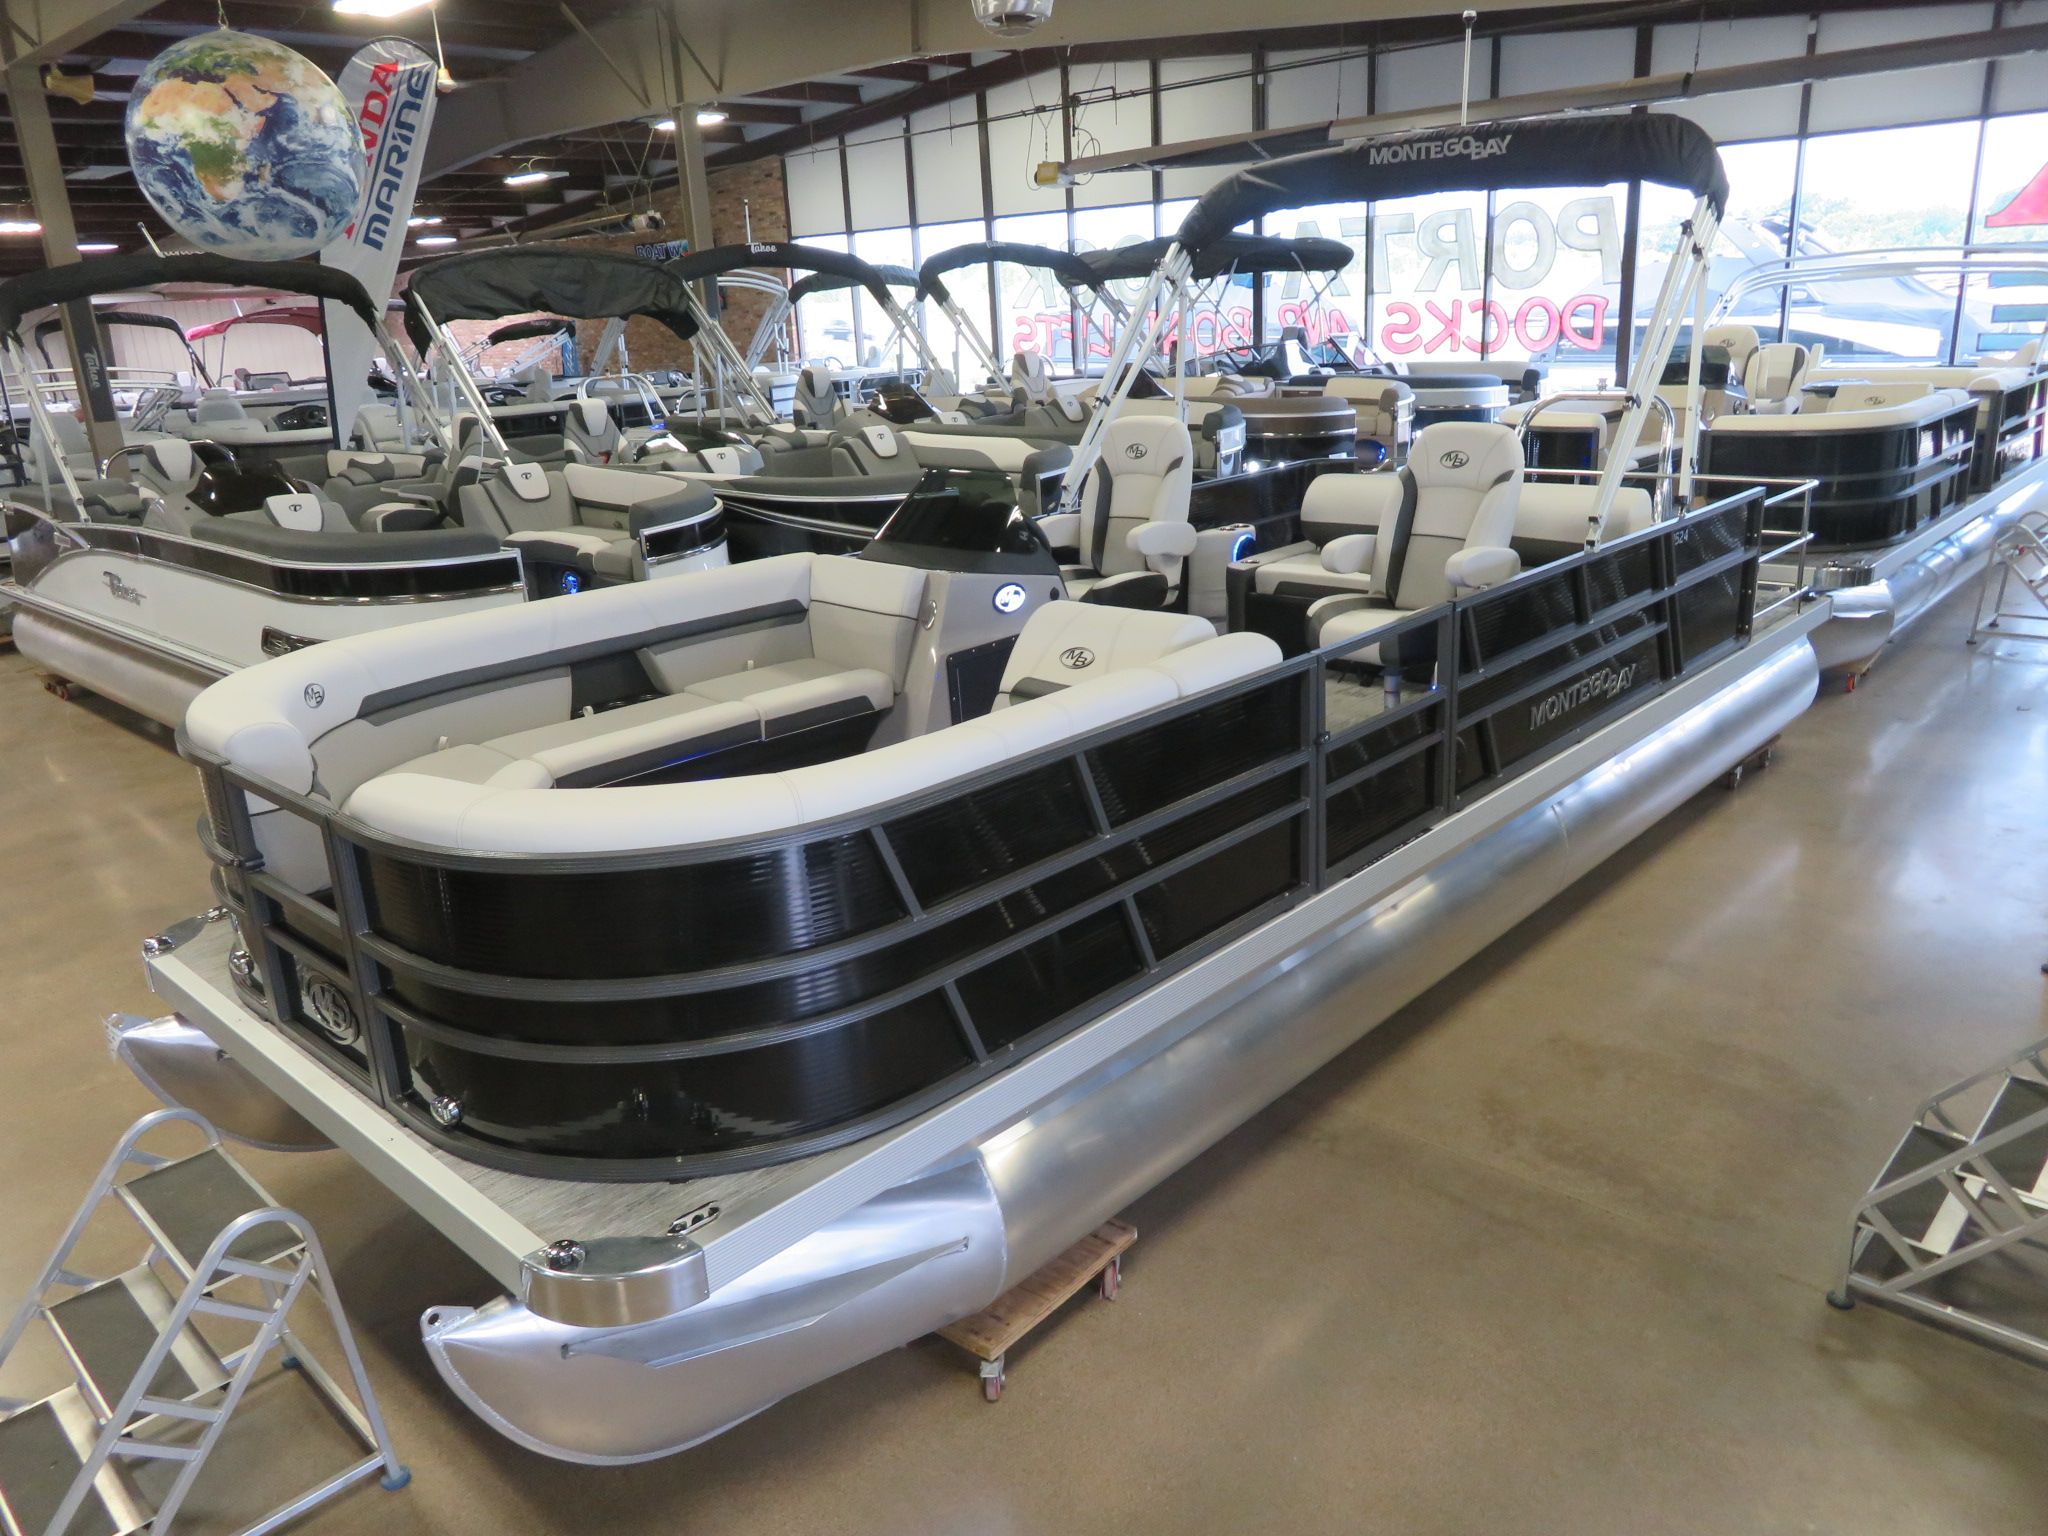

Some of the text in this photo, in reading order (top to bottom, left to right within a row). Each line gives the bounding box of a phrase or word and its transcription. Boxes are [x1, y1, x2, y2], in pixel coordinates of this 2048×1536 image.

[363, 66, 431, 251] MARINE
[636, 243, 666, 259] BOAT
[746, 242, 777, 254] Tahoe
